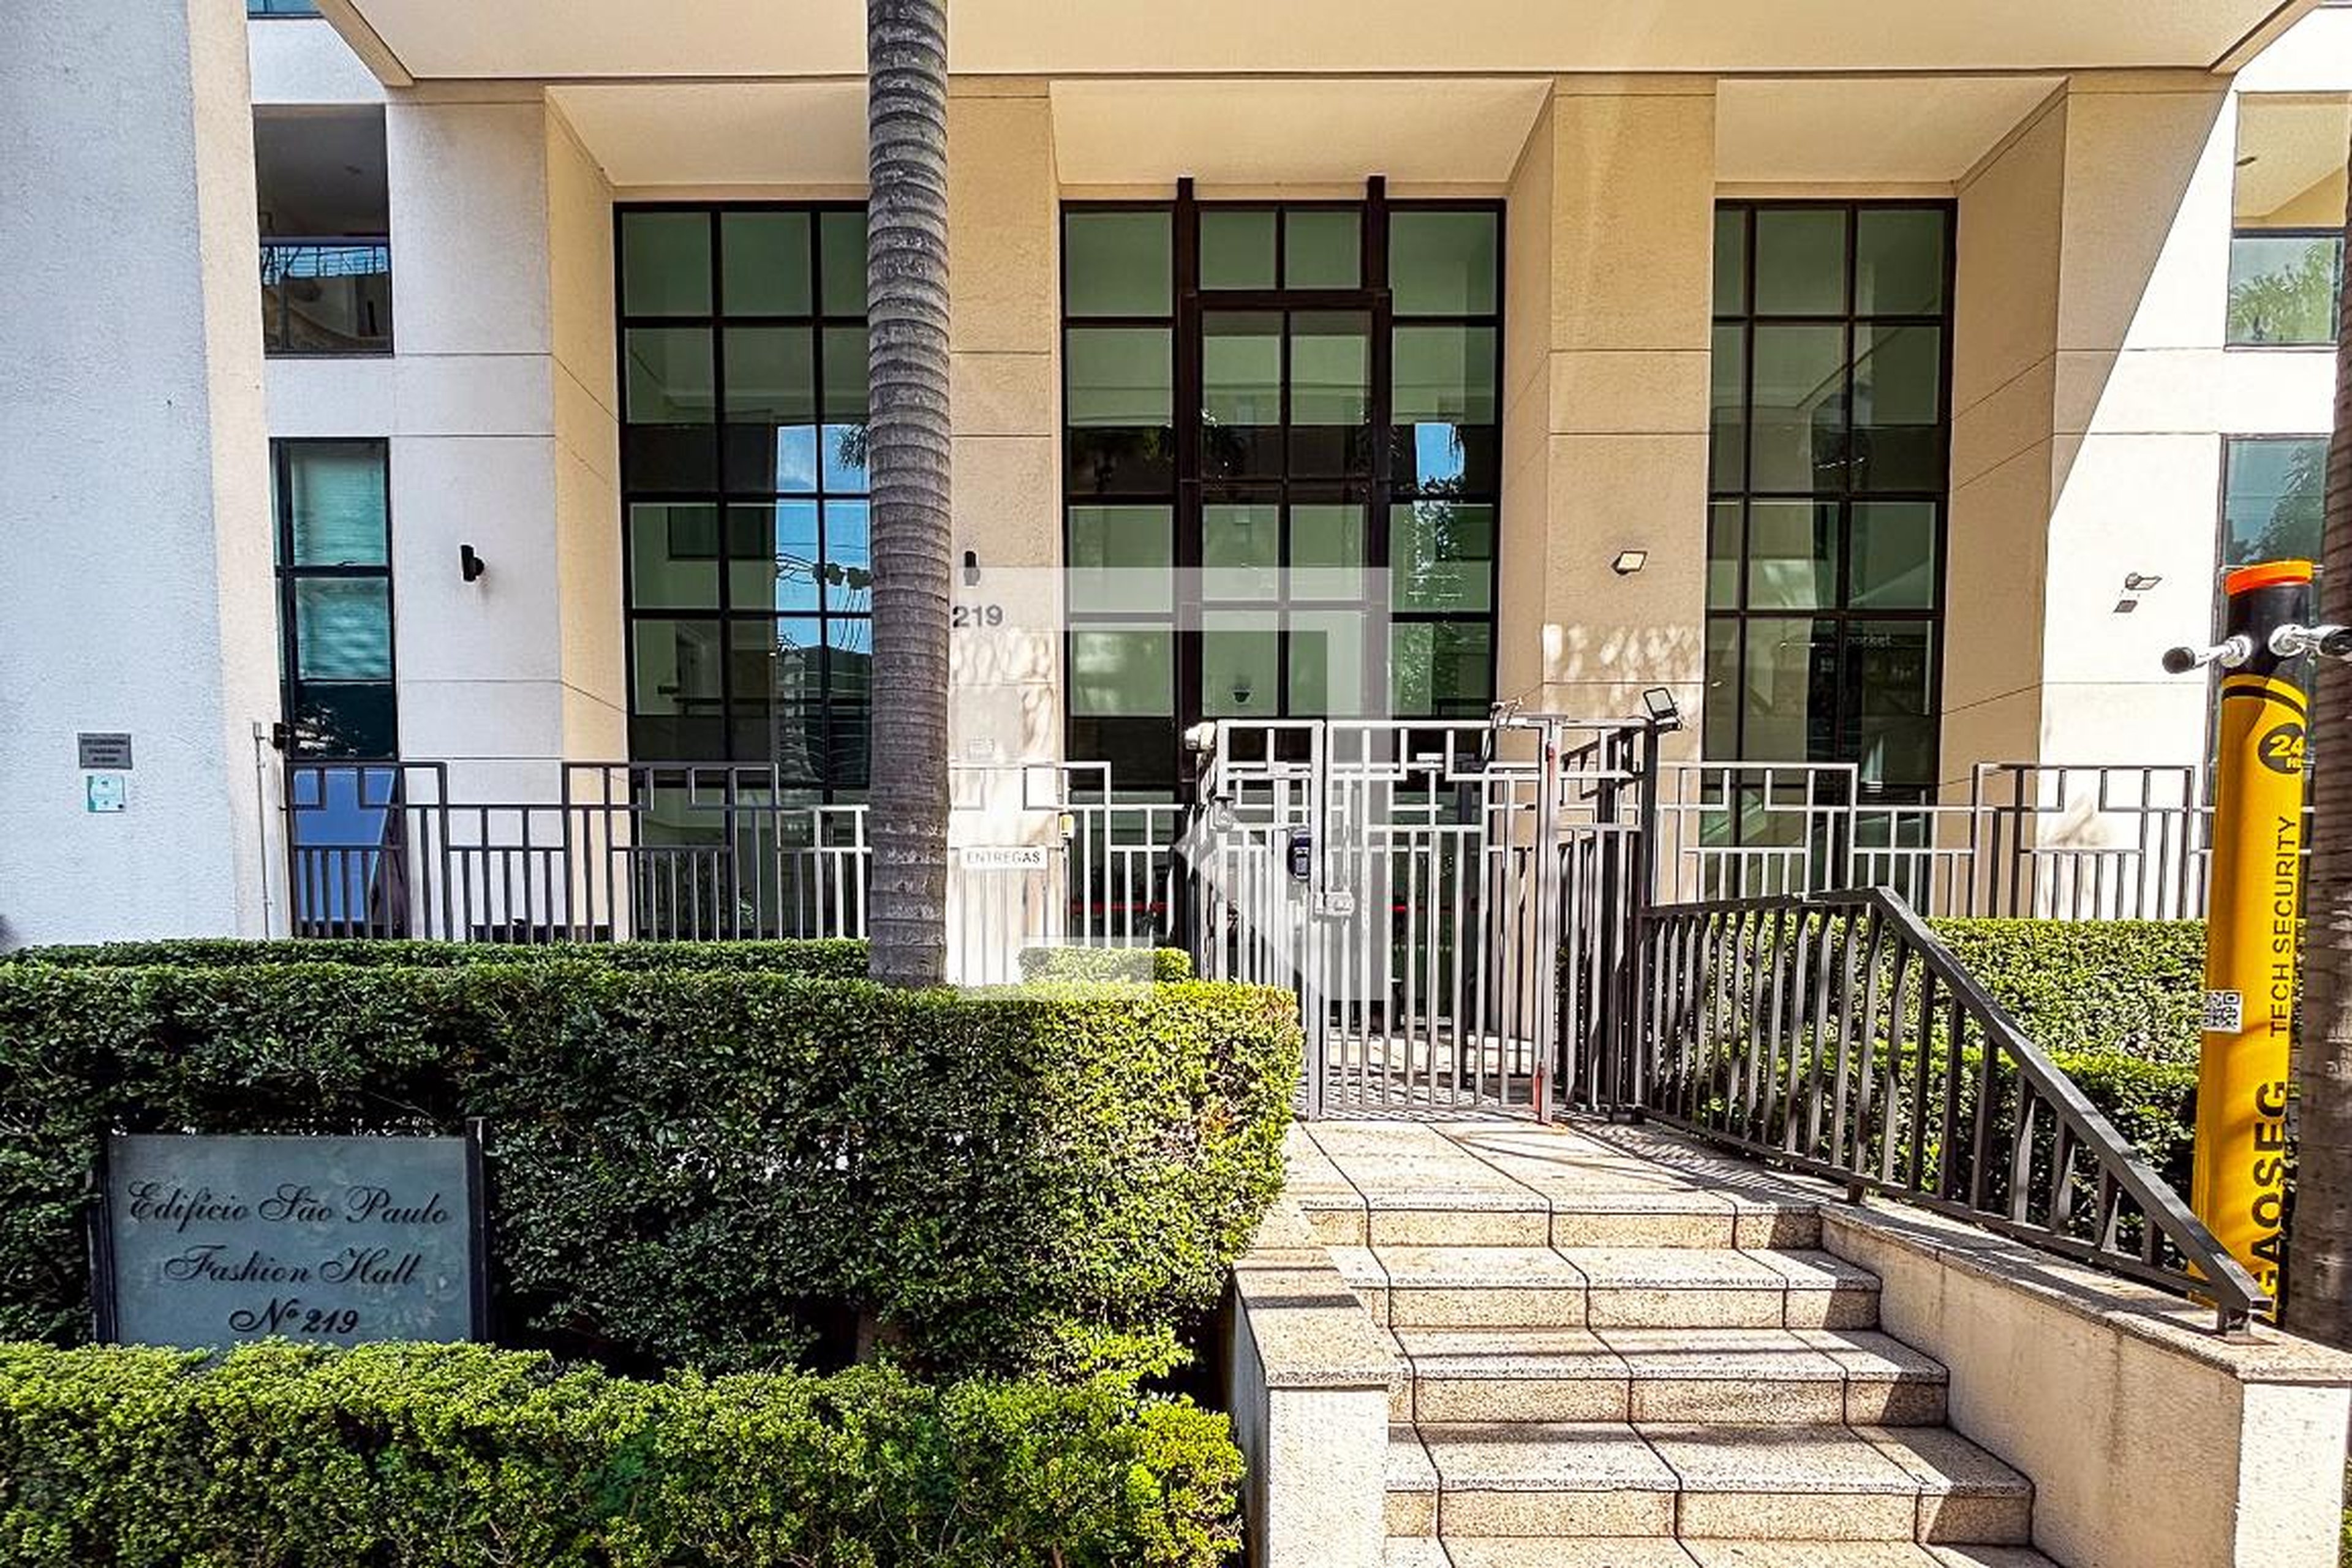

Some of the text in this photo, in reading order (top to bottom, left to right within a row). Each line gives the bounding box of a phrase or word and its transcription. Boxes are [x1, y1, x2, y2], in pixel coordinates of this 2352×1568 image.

[952, 604, 1003, 628] 219
[967, 849, 1040, 867] ENTREGAS
[2270, 816, 2296, 1038] TECH SECURITY
[258, 1183, 333, 1222] São
[345, 1185, 450, 1224] Paulo
[164, 1244, 422, 1284] Fashion Hall
[301, 1308, 358, 1334] 219
